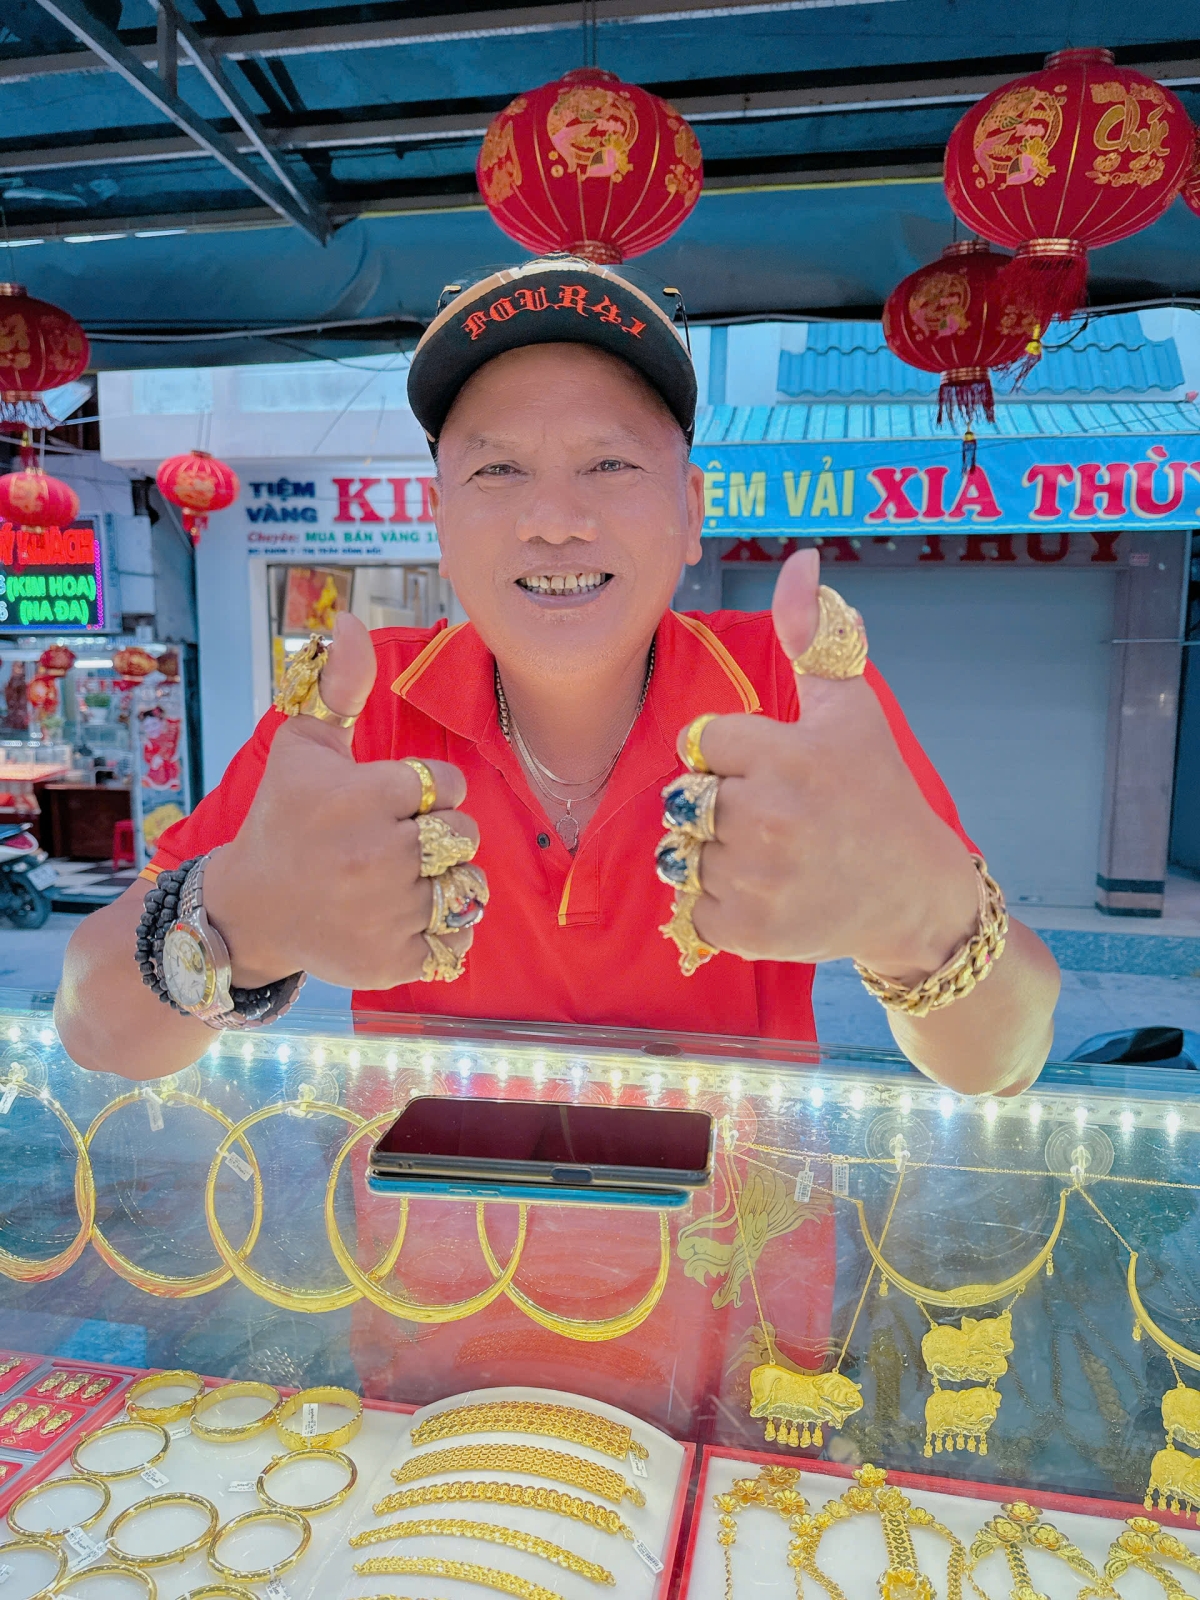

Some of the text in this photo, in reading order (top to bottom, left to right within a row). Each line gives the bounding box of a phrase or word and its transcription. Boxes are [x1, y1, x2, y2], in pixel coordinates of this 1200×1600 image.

[248, 477, 316, 502] TIỆM
[703, 460, 767, 528] ỆM
[783, 455, 855, 517] VẢI
[864, 465, 1002, 525] XIA
[245, 503, 319, 524] VÀNG
[305, 531, 336, 542] MUA
[343, 530, 373, 542] BÁN
[381, 529, 420, 543] VÀNG
